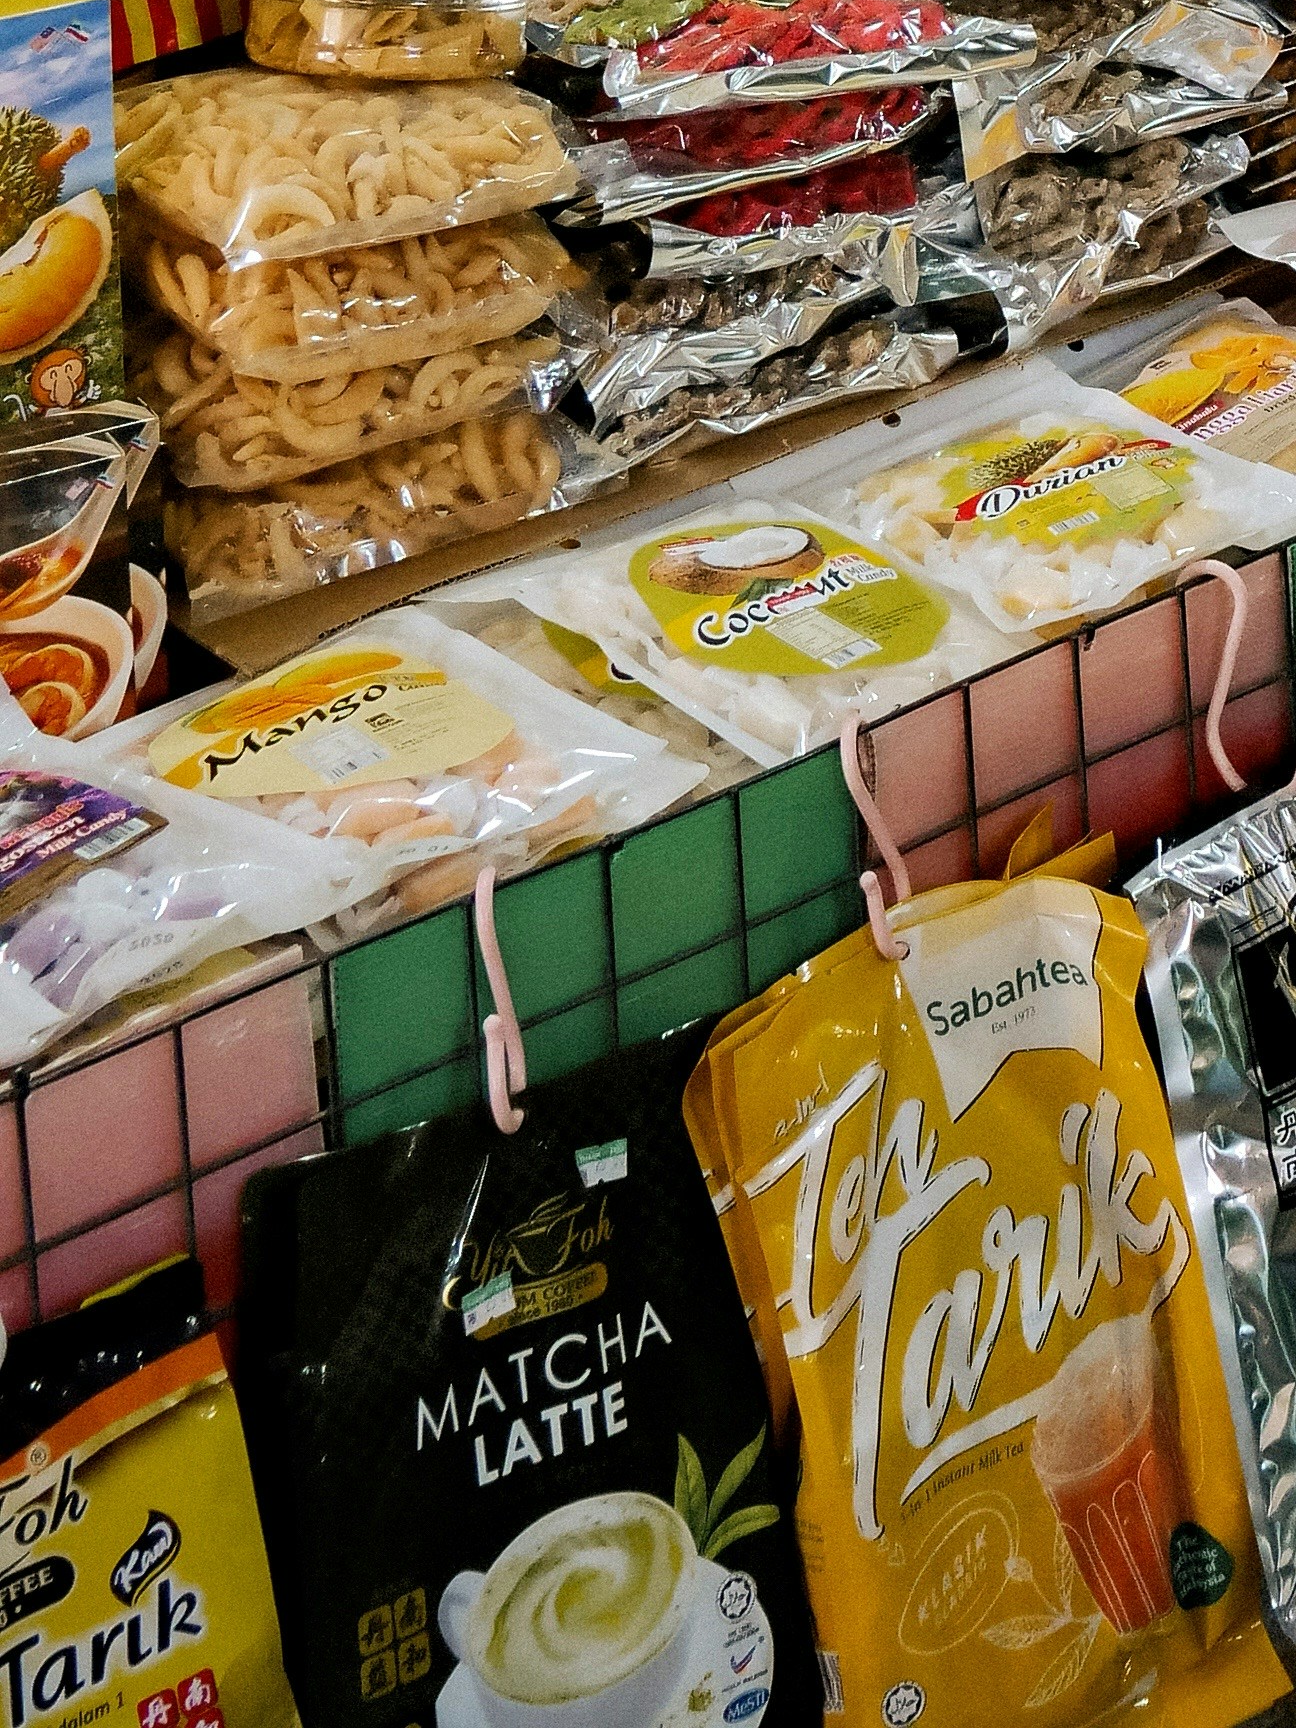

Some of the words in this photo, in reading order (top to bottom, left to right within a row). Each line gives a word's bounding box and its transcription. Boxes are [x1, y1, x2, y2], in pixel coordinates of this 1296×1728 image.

[978, 452, 1126, 521] Durian
[202, 679, 389, 783] Mango
[926, 958, 1089, 1037] Sabahtea
[785, 1086, 1192, 1540] Tarik
[415, 1301, 672, 1451] MATCHA
[474, 1381, 628, 1487] LATTE
[932, 1463, 976, 1493] Instant
[978, 1450, 1003, 1473] Milk
[1004, 1443, 1025, 1460] Tea
[0, 1578, 202, 1728] Tarik
